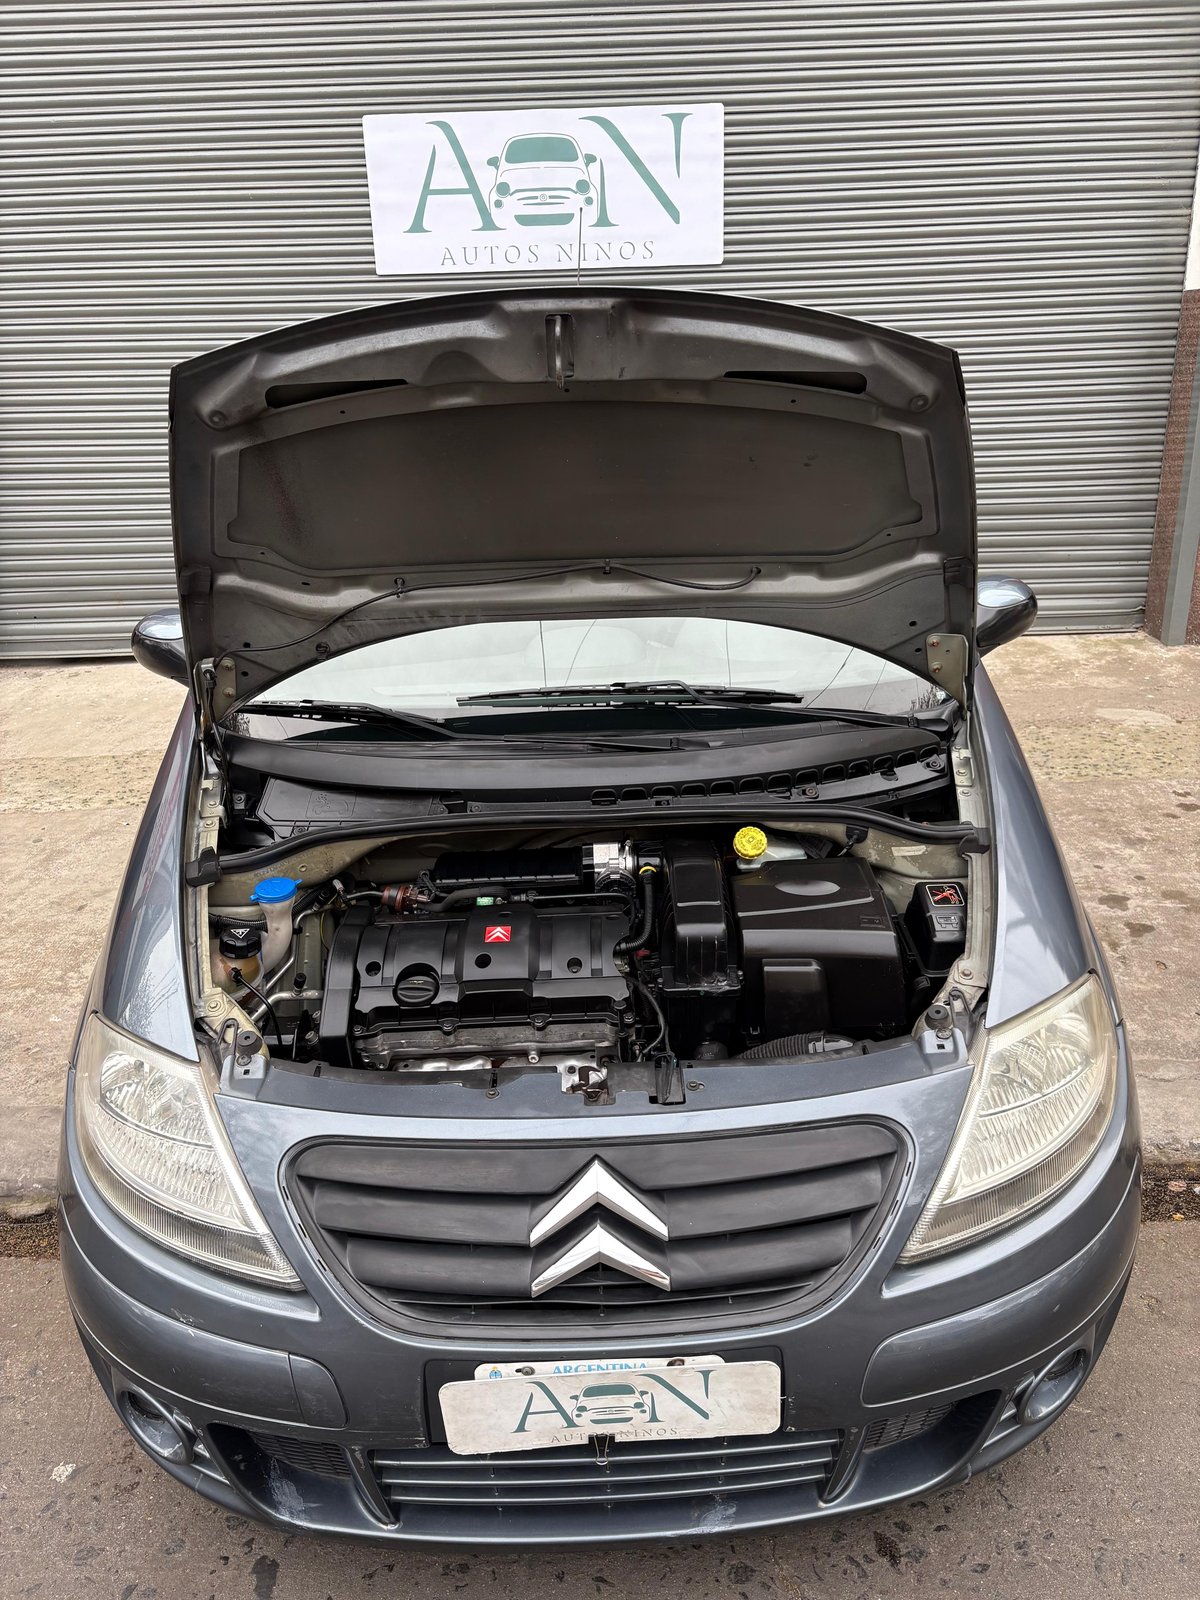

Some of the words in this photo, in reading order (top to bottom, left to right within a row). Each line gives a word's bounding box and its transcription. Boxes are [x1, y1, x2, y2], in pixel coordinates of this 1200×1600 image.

[441, 244, 539, 266] AUTOS
[555, 241, 654, 262] NINOS
[552, 1362, 647, 1374] ARGENTINA
[551, 1430, 610, 1443] AUT
